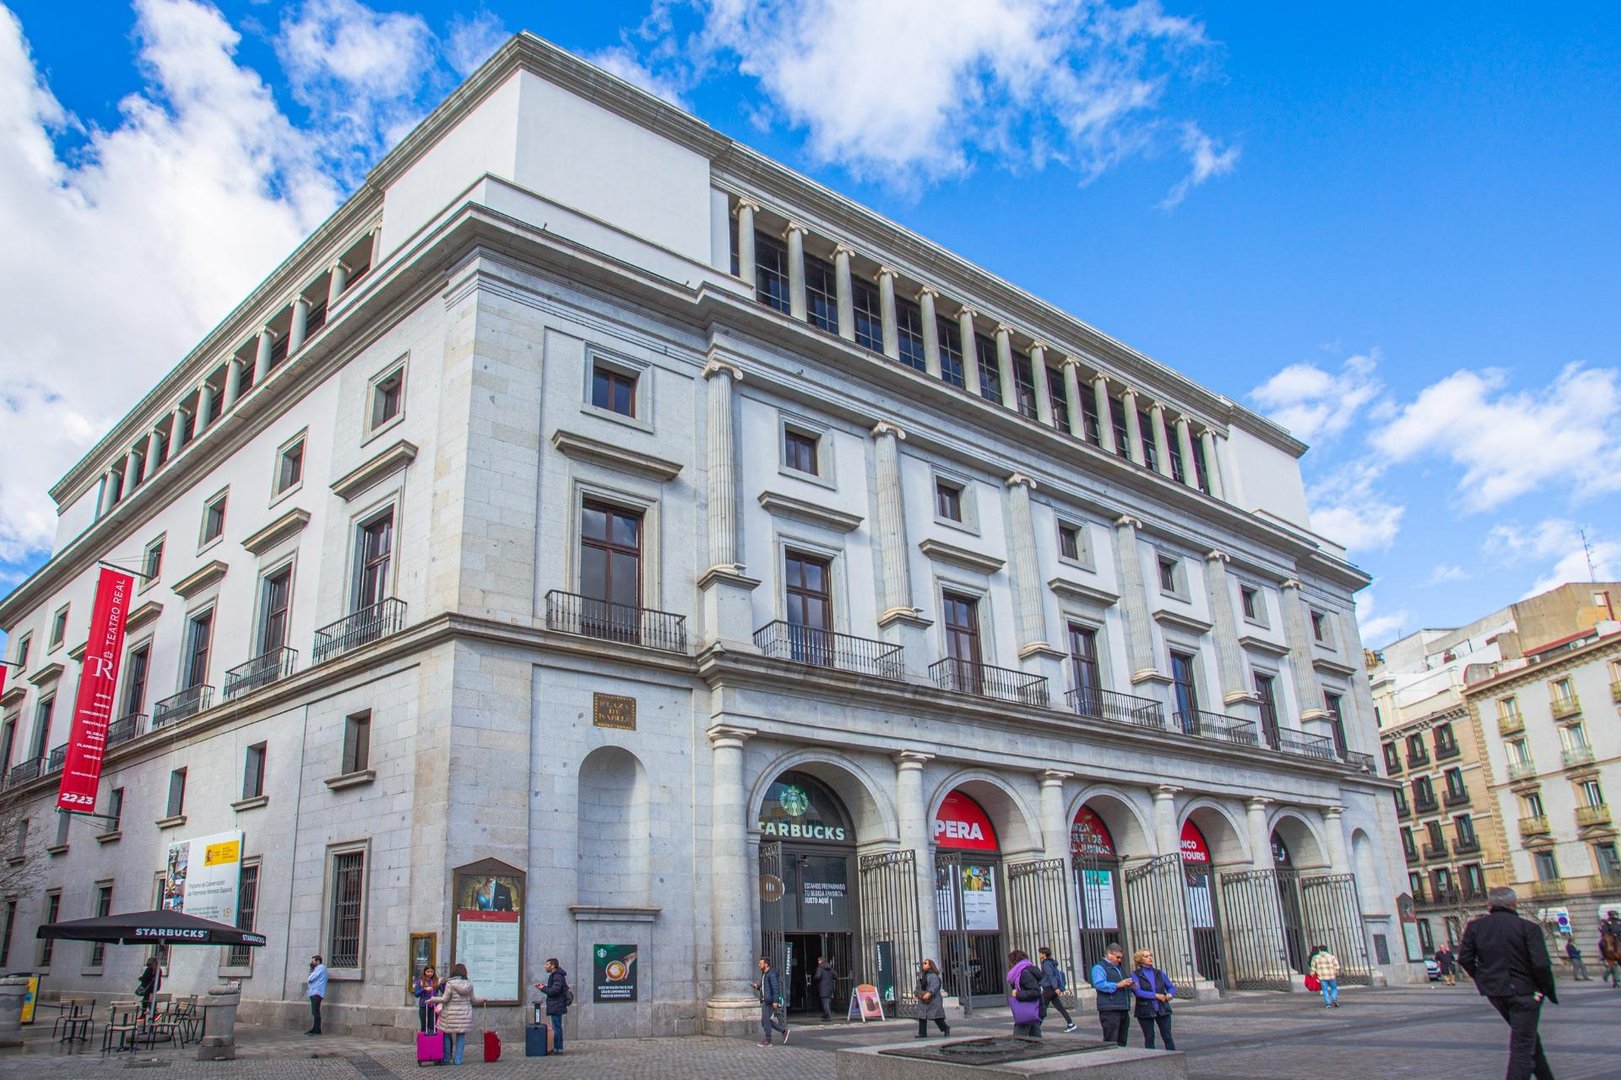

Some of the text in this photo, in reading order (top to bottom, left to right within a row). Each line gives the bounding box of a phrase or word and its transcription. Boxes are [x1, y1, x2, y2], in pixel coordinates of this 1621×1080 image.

[106, 579, 126, 646] TEATRO REAL
[1181, 851, 1205, 861] TOURS
[242, 934, 265, 943] STARBUCKS
